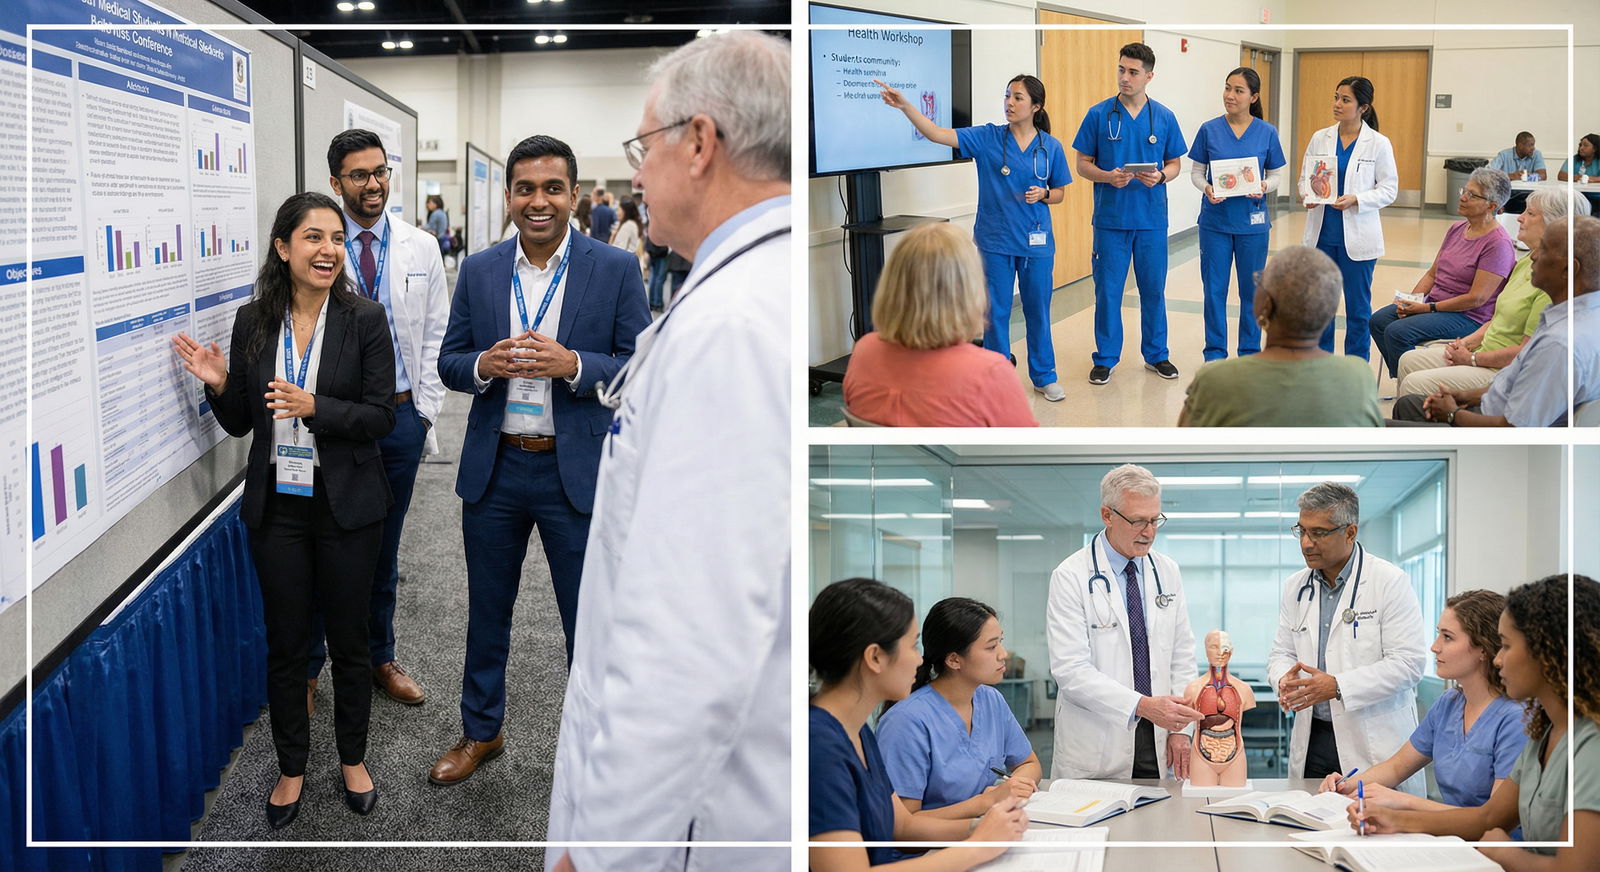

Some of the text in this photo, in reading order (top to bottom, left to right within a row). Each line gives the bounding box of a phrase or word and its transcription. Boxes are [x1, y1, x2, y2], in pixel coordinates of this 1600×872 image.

[98, 0, 131, 21] Medical
[132, 30, 174, 57] Conference
[848, 29, 924, 47] Health Workshop
[843, 68, 863, 76] Health
